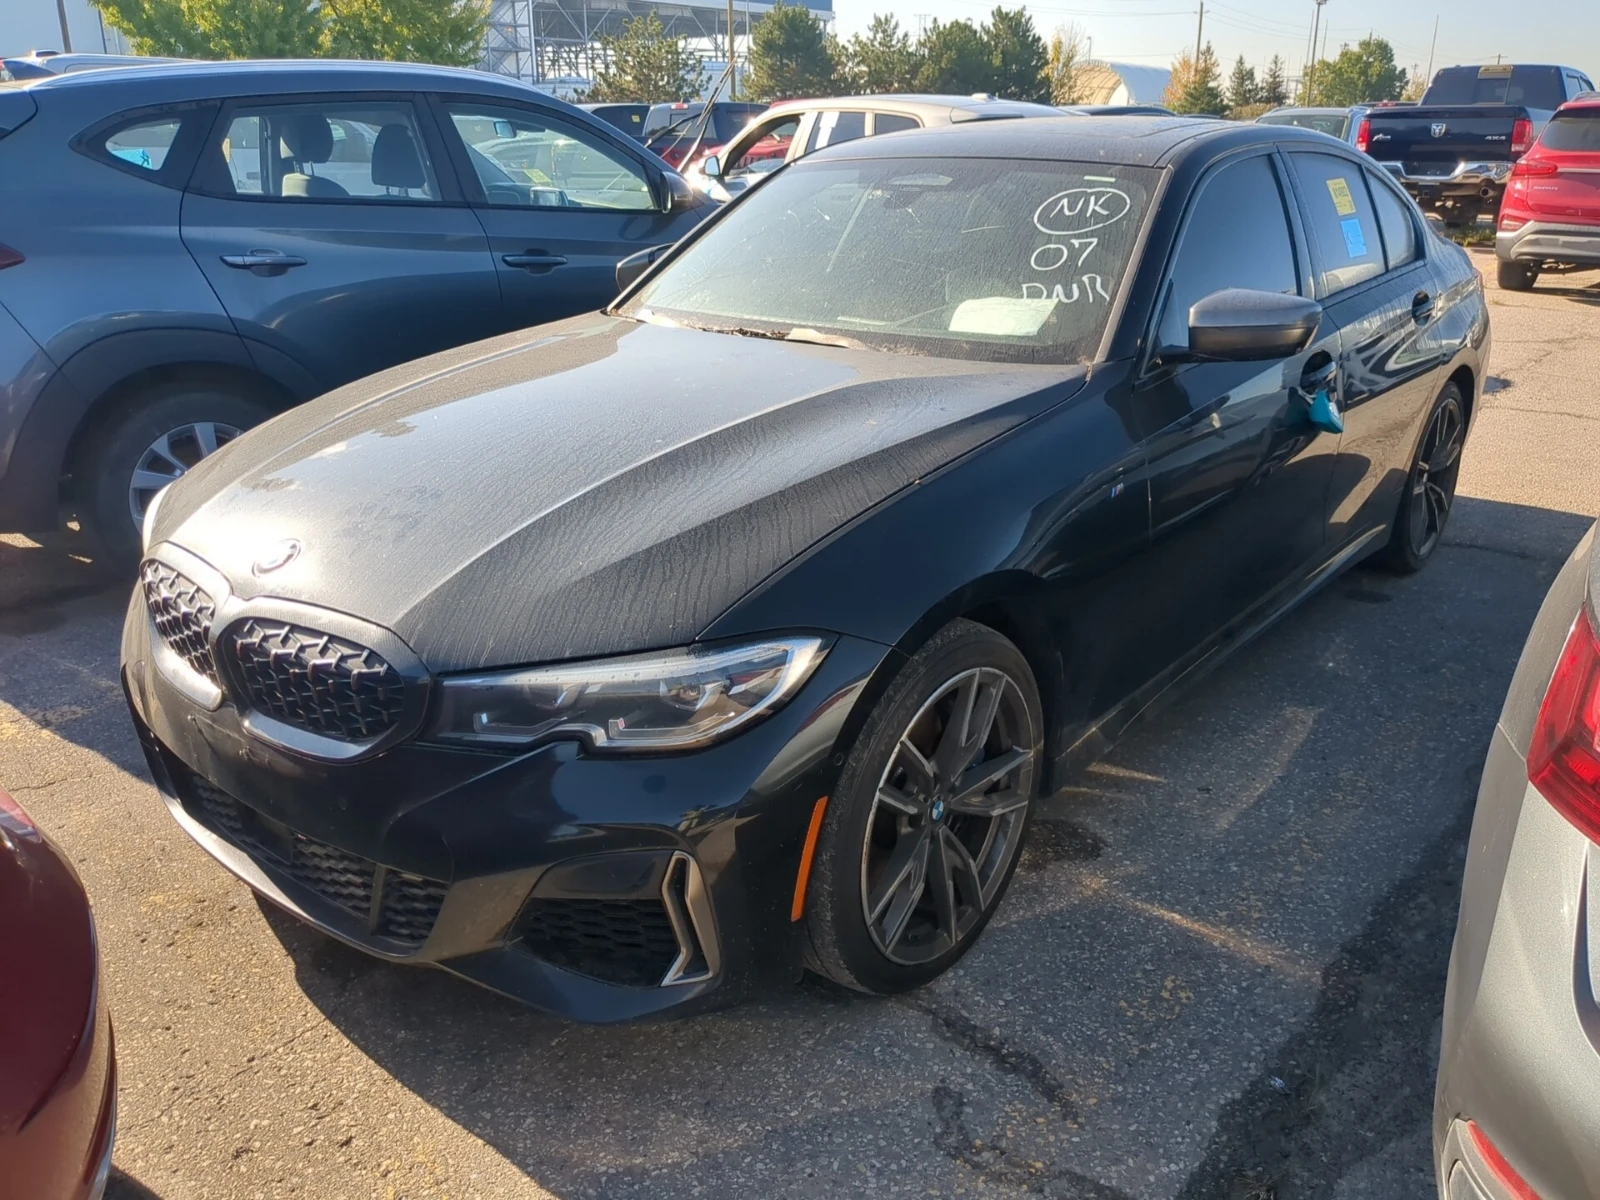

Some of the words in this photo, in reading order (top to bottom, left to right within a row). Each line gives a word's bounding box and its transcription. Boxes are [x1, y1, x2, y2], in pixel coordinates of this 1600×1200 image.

[1049, 192, 1113, 218] NK
[1030, 237, 1098, 271] 07
[1021, 273, 1111, 303] DNR
